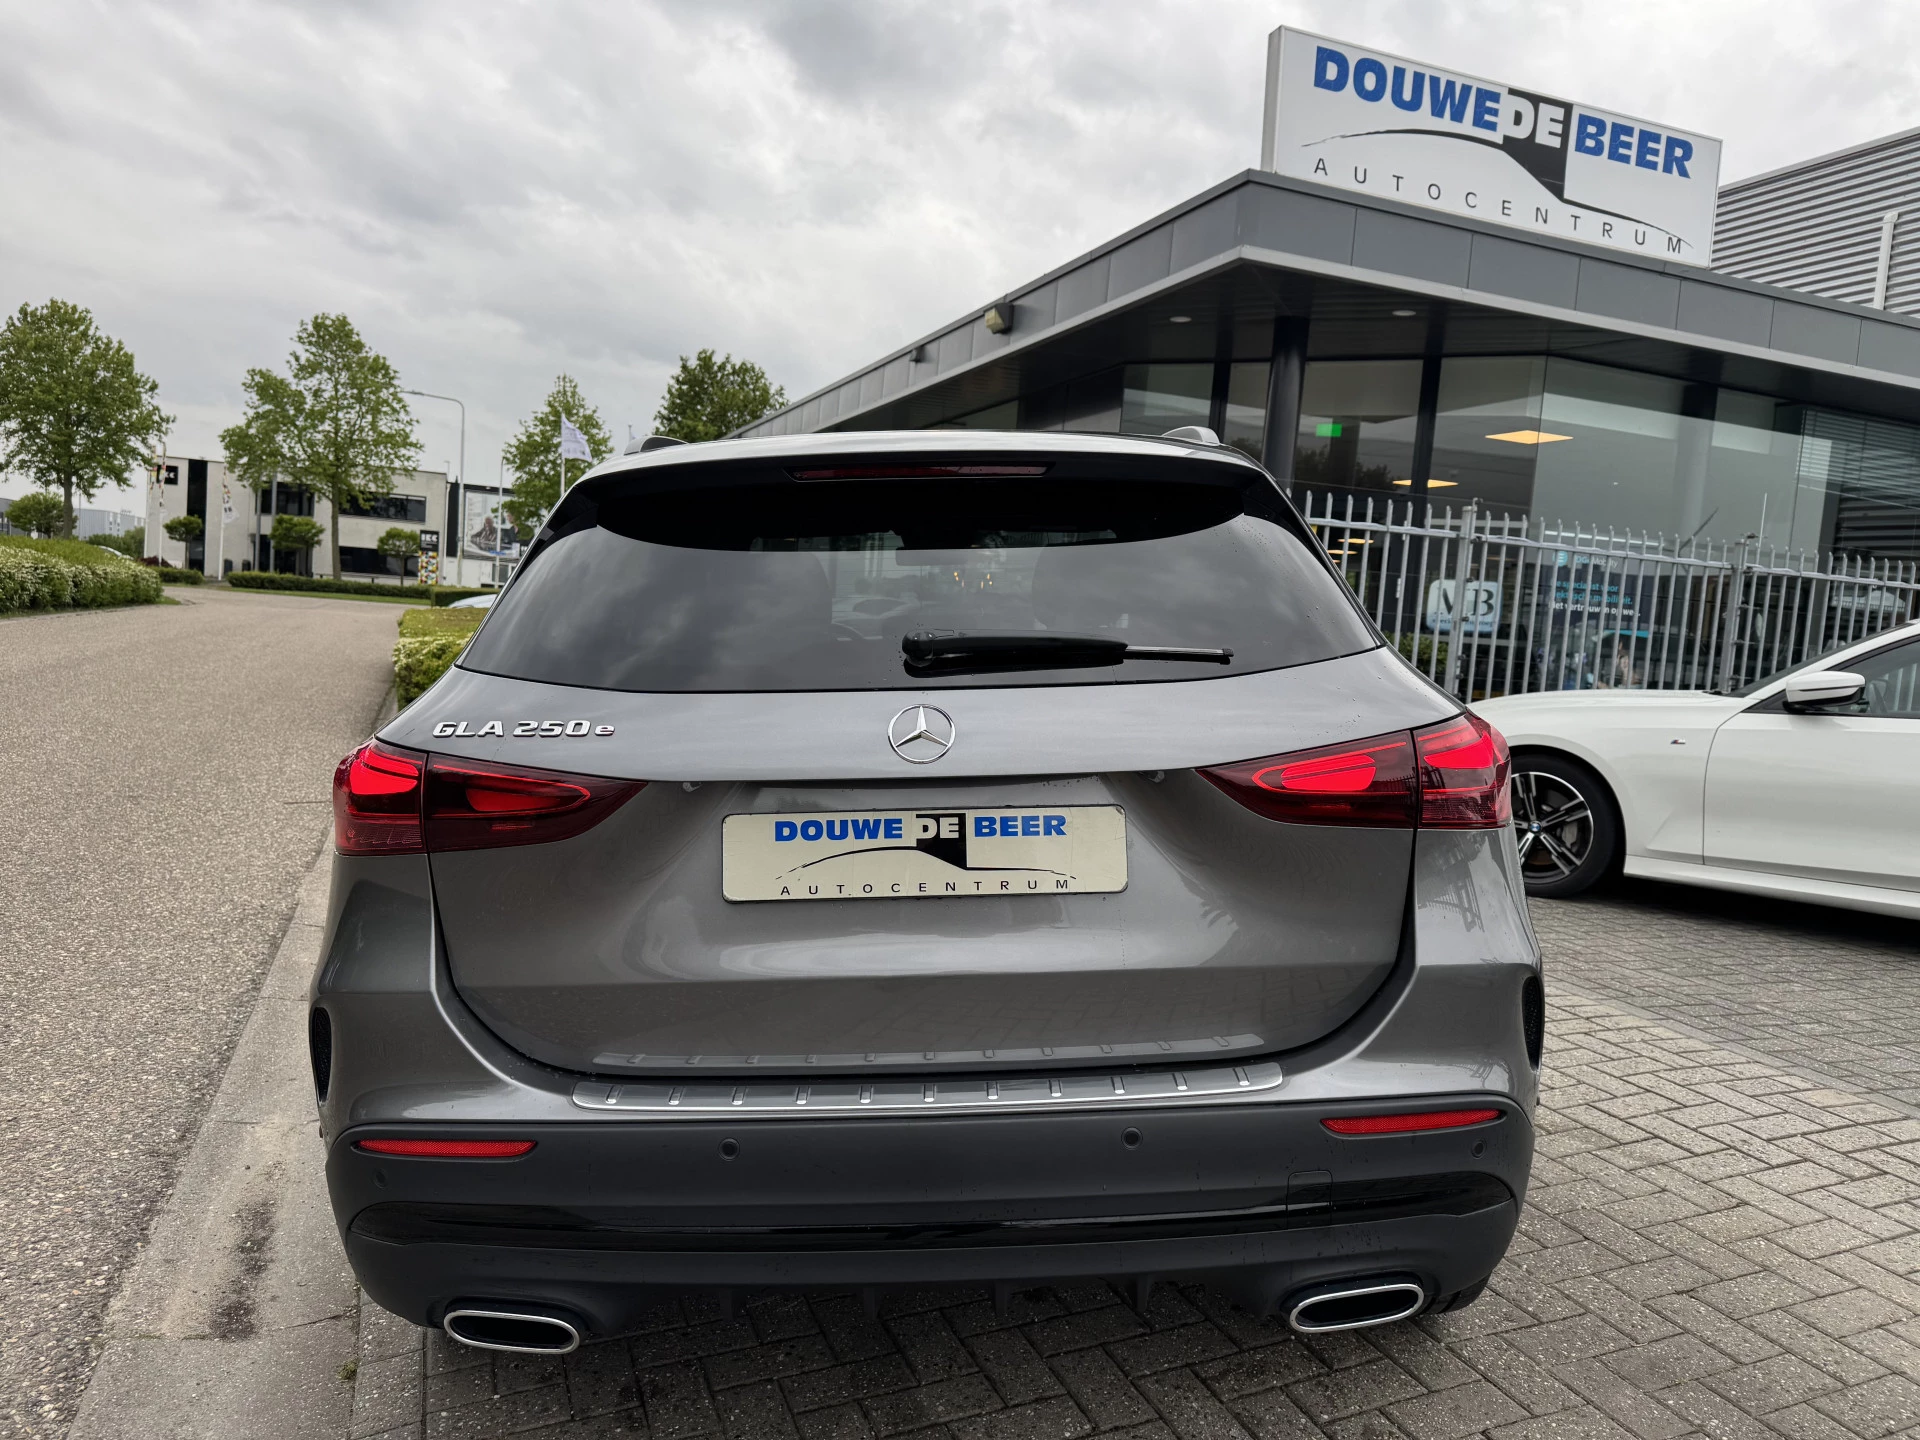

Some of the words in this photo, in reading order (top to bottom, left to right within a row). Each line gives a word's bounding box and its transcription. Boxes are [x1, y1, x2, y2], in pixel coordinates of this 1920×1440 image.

[1313, 45, 1501, 132] DOUWE
[1503, 94, 1565, 149] DE
[1574, 112, 1694, 179] BEER
[1313, 157, 1682, 255] AUTOCENTRUM
[1562, 580, 1600, 591] spciast
[1565, 603, 1610, 613] vertruwn
[1623, 609, 1641, 617] we.
[432, 720, 504, 738] GLA
[774, 818, 904, 842] DOUWE
[915, 815, 960, 840] DE
[973, 814, 1067, 838] BEER
[780, 879, 1069, 897] AUTOCENTRUM
